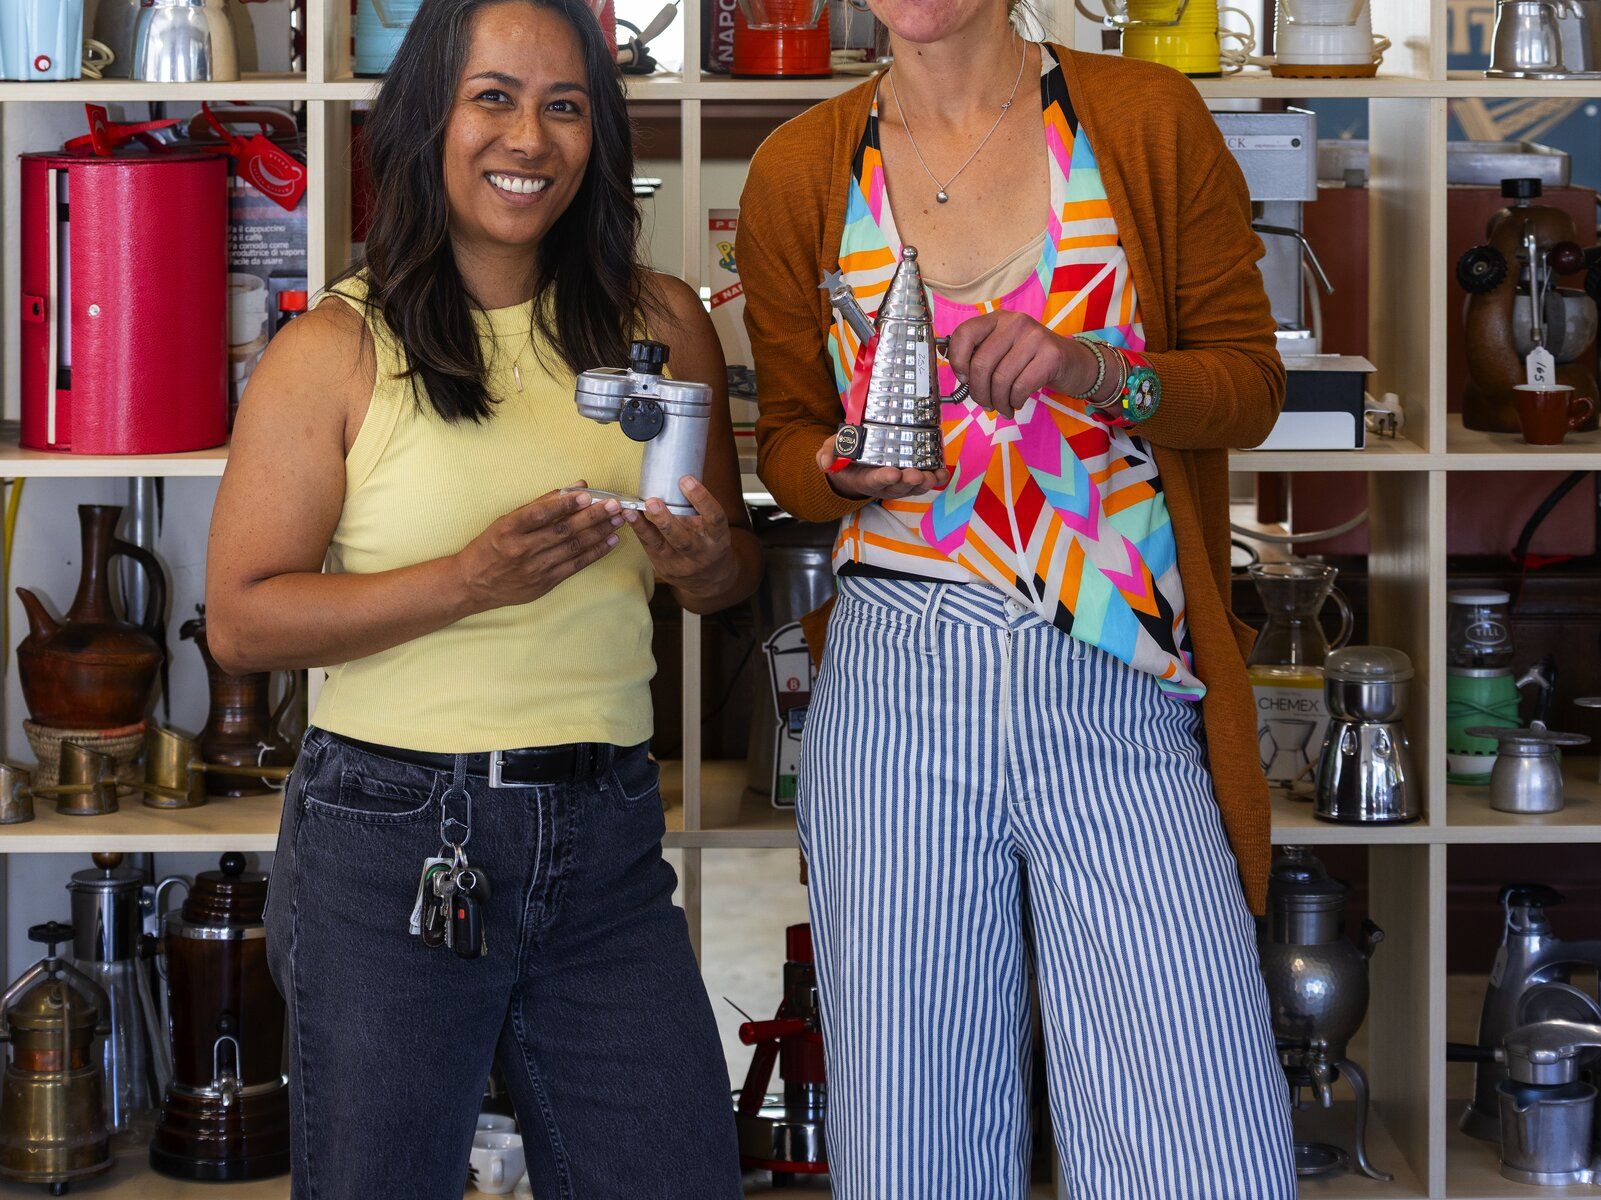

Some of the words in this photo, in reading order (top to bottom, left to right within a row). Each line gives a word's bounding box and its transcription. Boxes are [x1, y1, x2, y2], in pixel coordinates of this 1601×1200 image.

[245, 223, 286, 233] cappuccino
[239, 241, 267, 249] comodo
[279, 249, 305, 257] vapore
[251, 257, 261, 265] da
[1534, 361, 1547, 383] 165
[789, 680, 799, 691] B
[1258, 697, 1319, 712] CHEMEX
